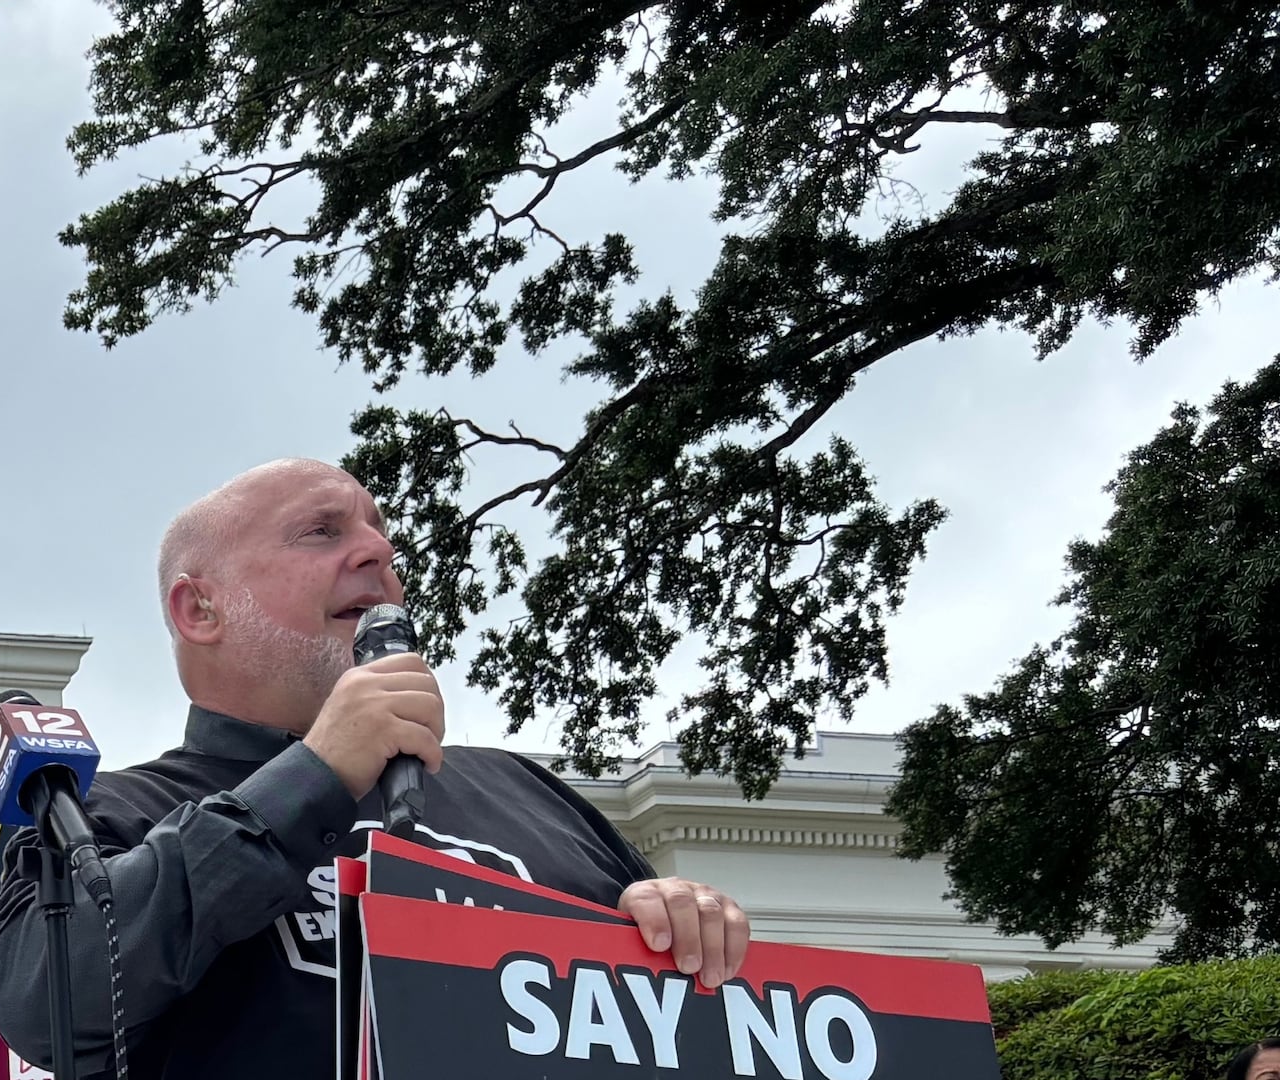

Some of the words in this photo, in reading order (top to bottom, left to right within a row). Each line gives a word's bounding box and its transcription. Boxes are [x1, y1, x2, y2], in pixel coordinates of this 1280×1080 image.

[11, 711, 83, 736] 12
[22, 736, 93, 751] WSFA
[500, 959, 688, 1070] SAY
